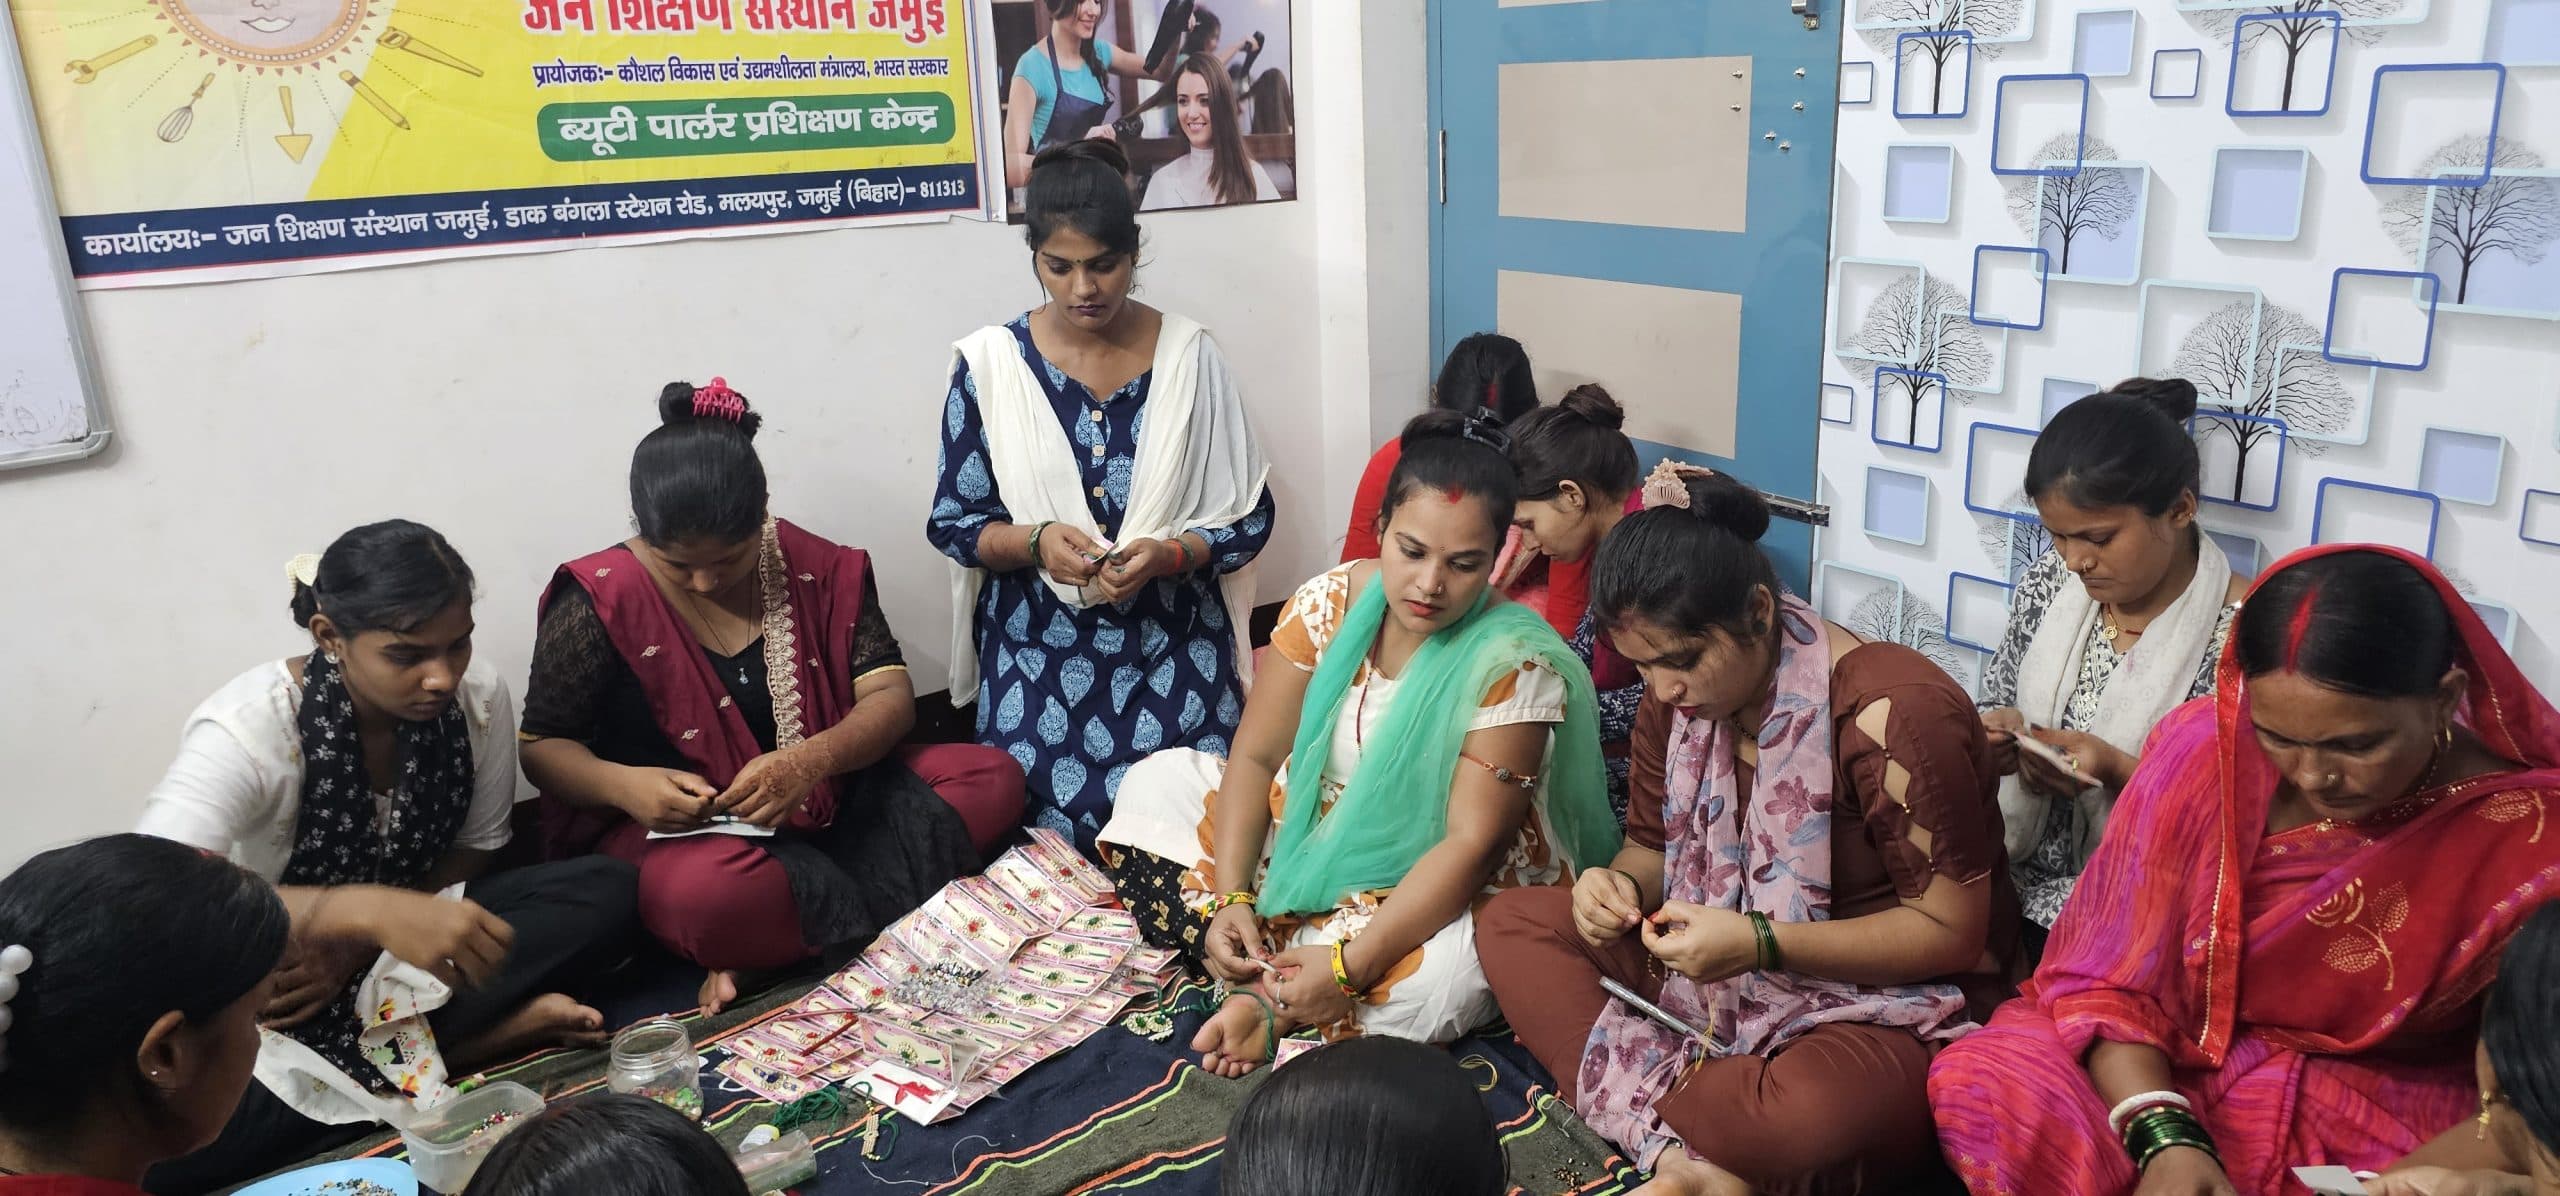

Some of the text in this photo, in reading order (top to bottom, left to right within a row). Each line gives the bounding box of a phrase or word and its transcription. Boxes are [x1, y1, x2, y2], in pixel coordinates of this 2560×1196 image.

[618, 56, 665, 83] कौशल
[668, 56, 716, 81] विकास
[719, 56, 740, 80] एवं
[743, 54, 816, 79] उद्यमशीलता
[820, 55, 870, 79] मंत्रालय,
[874, 59, 905, 77] भारत
[908, 59, 948, 76] सरकार
[558, 97, 938, 157] ब्यूटी पार्लर प्रशिक्षण केन्द्र
[223, 222, 270, 246] जन
[276, 213, 346, 243] शिक्षण
[353, 209, 428, 238] संस्थान
[435, 201, 498, 240] जमुई,
[504, 202, 547, 227] डाक
[553, 196, 610, 222] बंगला
[615, 194, 672, 219] स्टेशन
[676, 190, 713, 215] रोड,
[718, 189, 792, 218] मलयपुर,
[797, 180, 842, 214] जमुई
